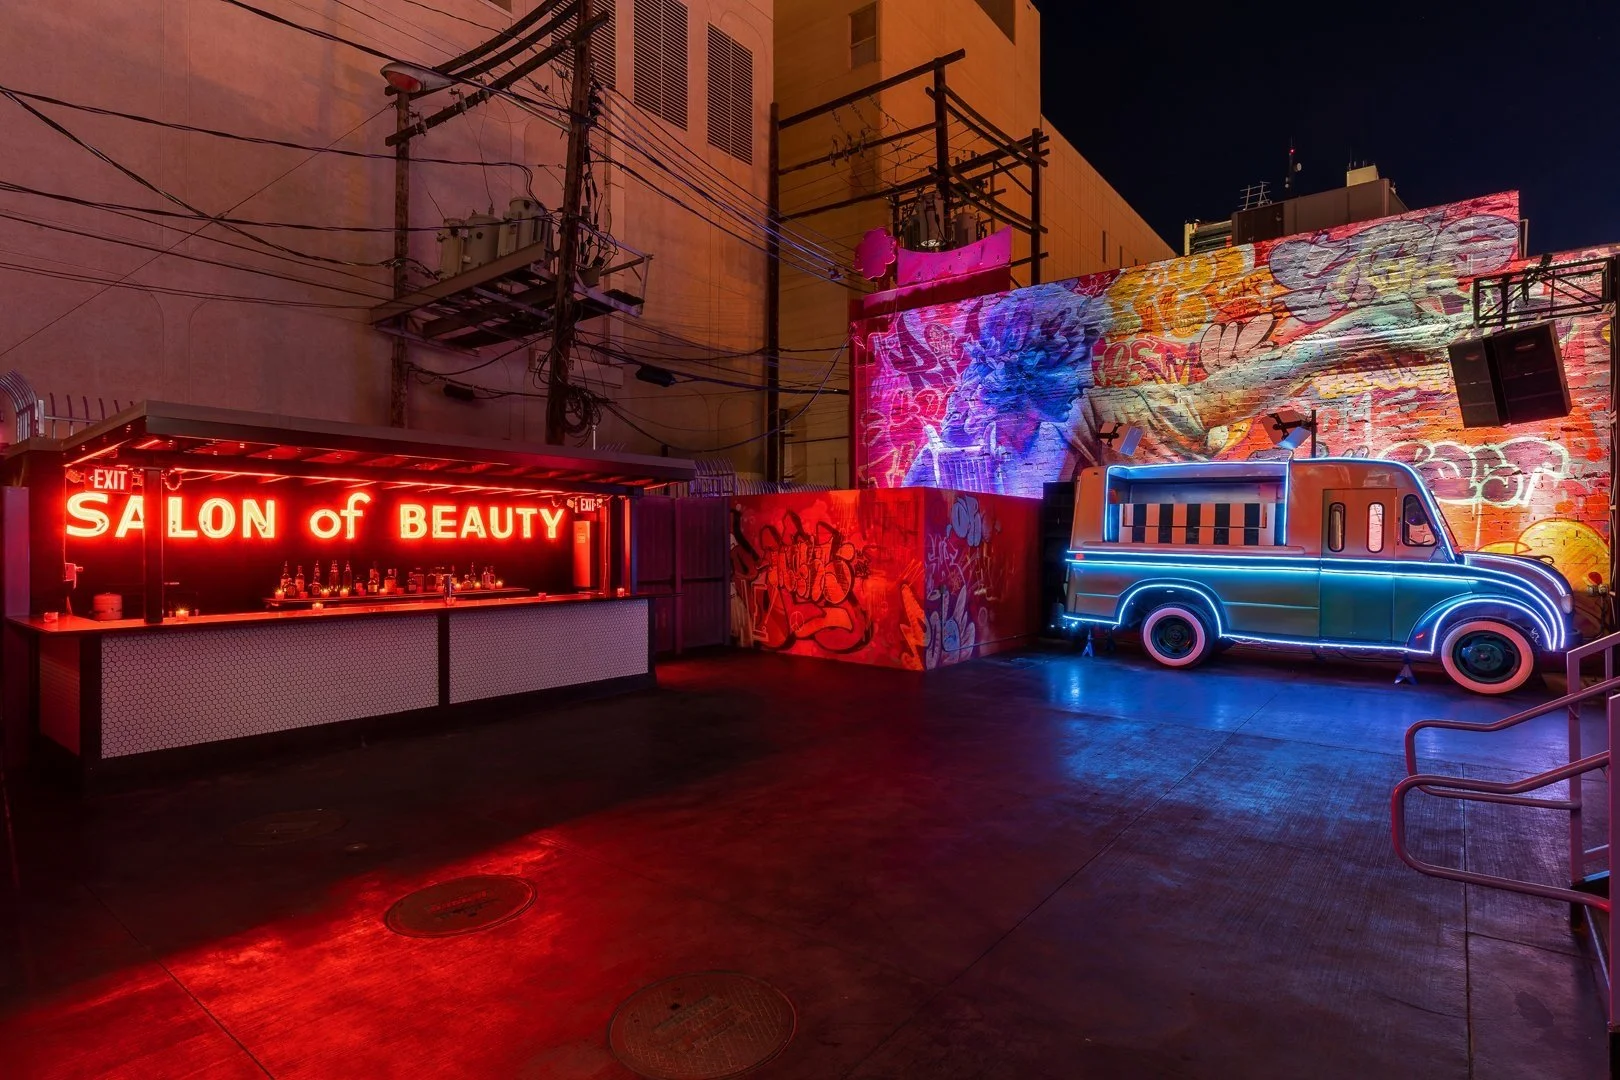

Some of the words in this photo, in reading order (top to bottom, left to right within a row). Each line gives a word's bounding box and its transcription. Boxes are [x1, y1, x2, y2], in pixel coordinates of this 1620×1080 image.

[94, 469, 127, 490] EXIT
[581, 498, 595, 511] EXIT
[67, 492, 275, 538] SALON
[310, 492, 371, 539] of
[400, 504, 565, 539] BEAUTY
